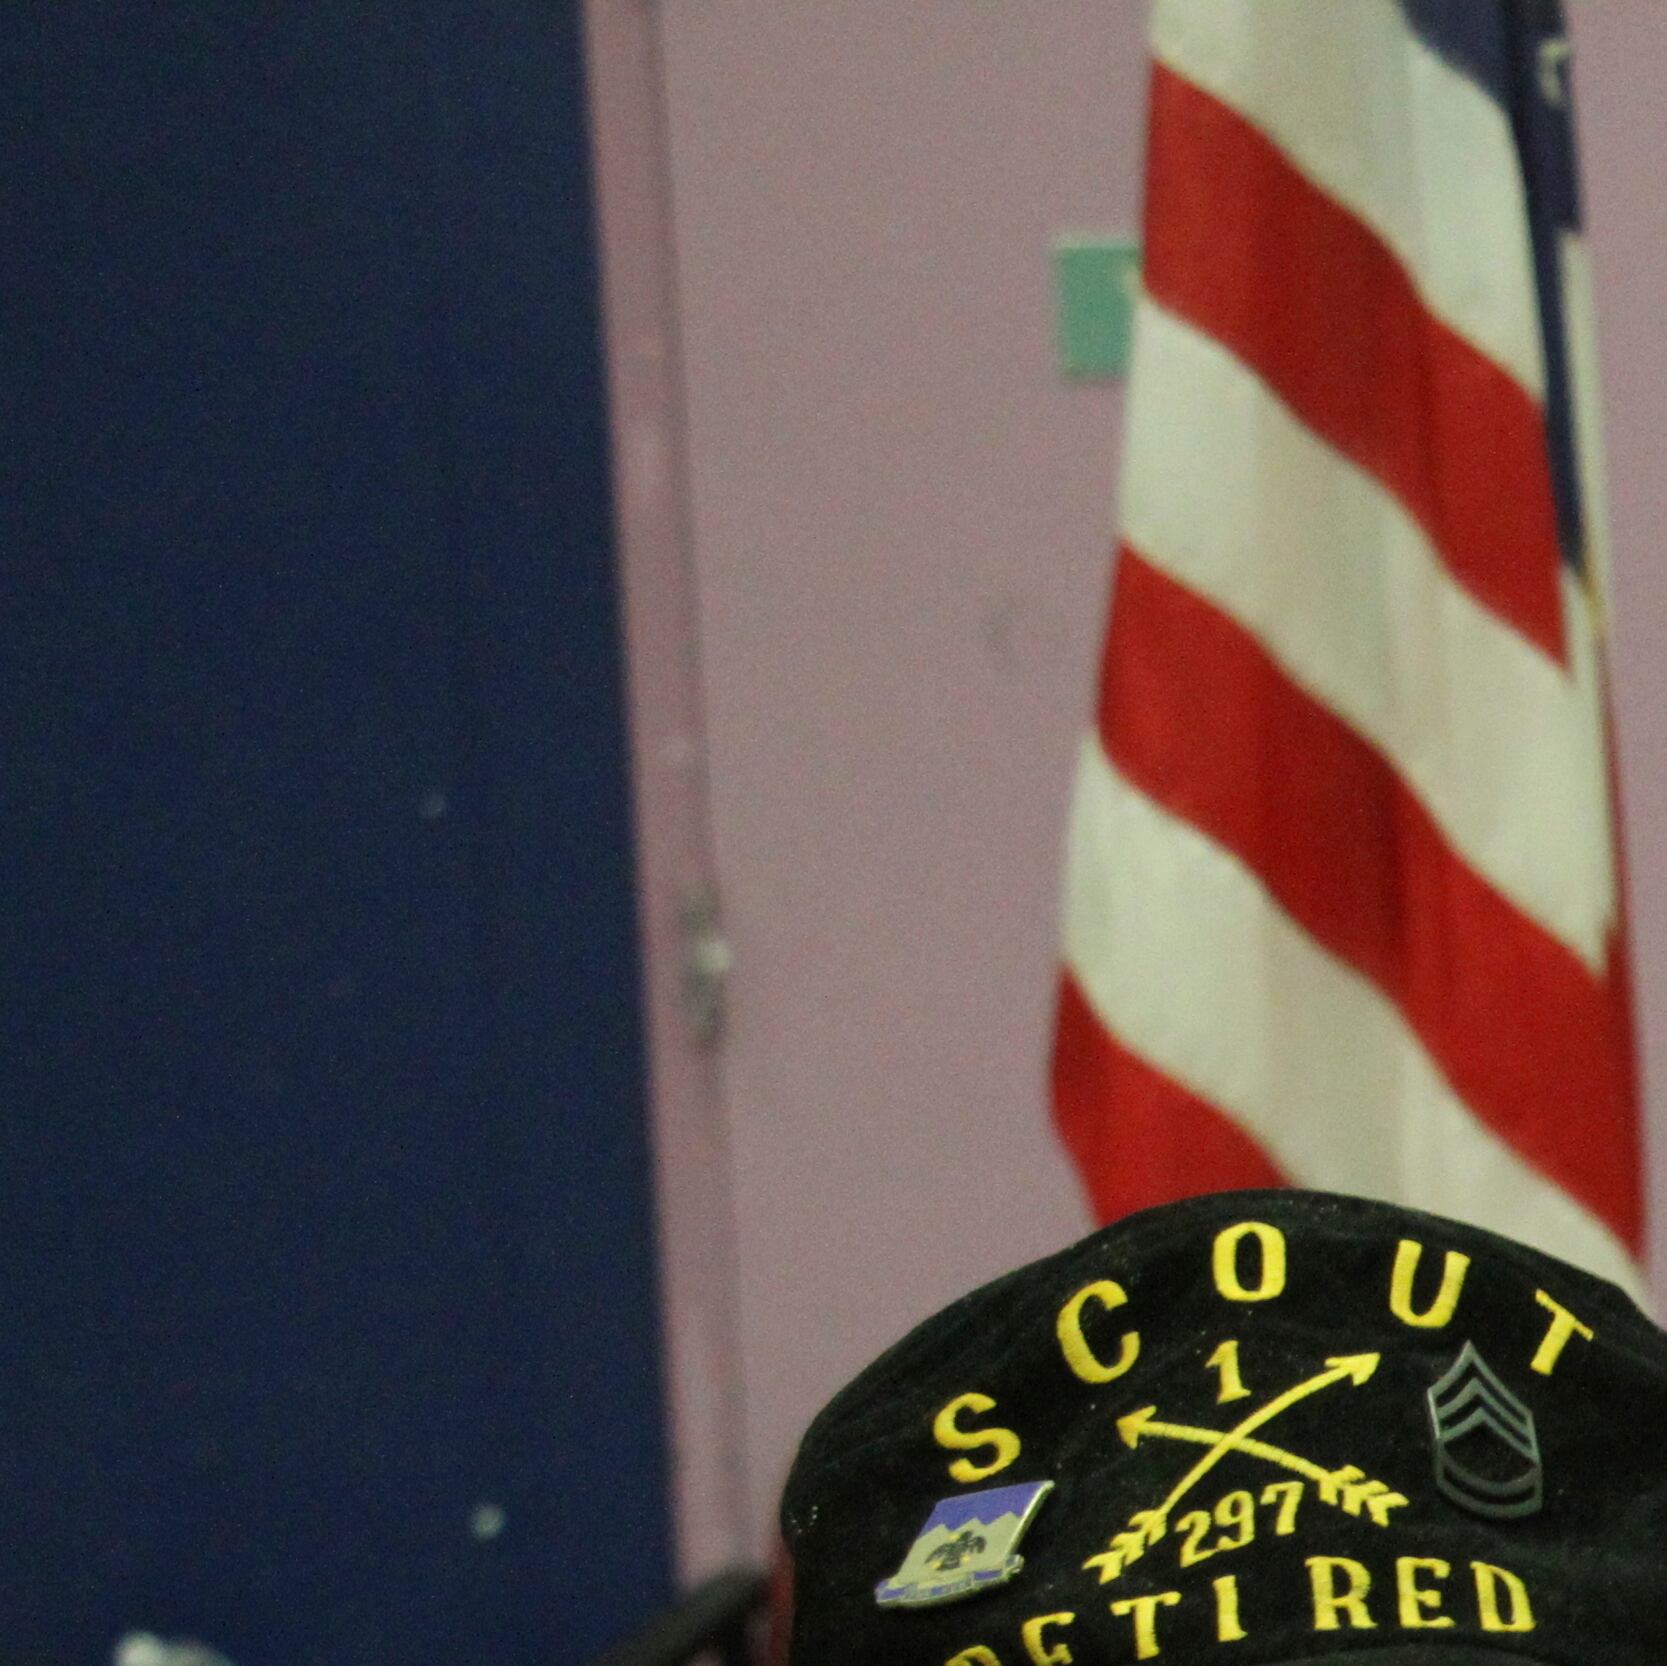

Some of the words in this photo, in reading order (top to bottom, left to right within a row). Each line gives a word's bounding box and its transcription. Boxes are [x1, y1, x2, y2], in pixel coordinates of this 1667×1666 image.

[931, 1220, 1595, 1485] SCOUT
[1204, 1339, 1252, 1404] 1
[1174, 1480, 1306, 1568] 297
